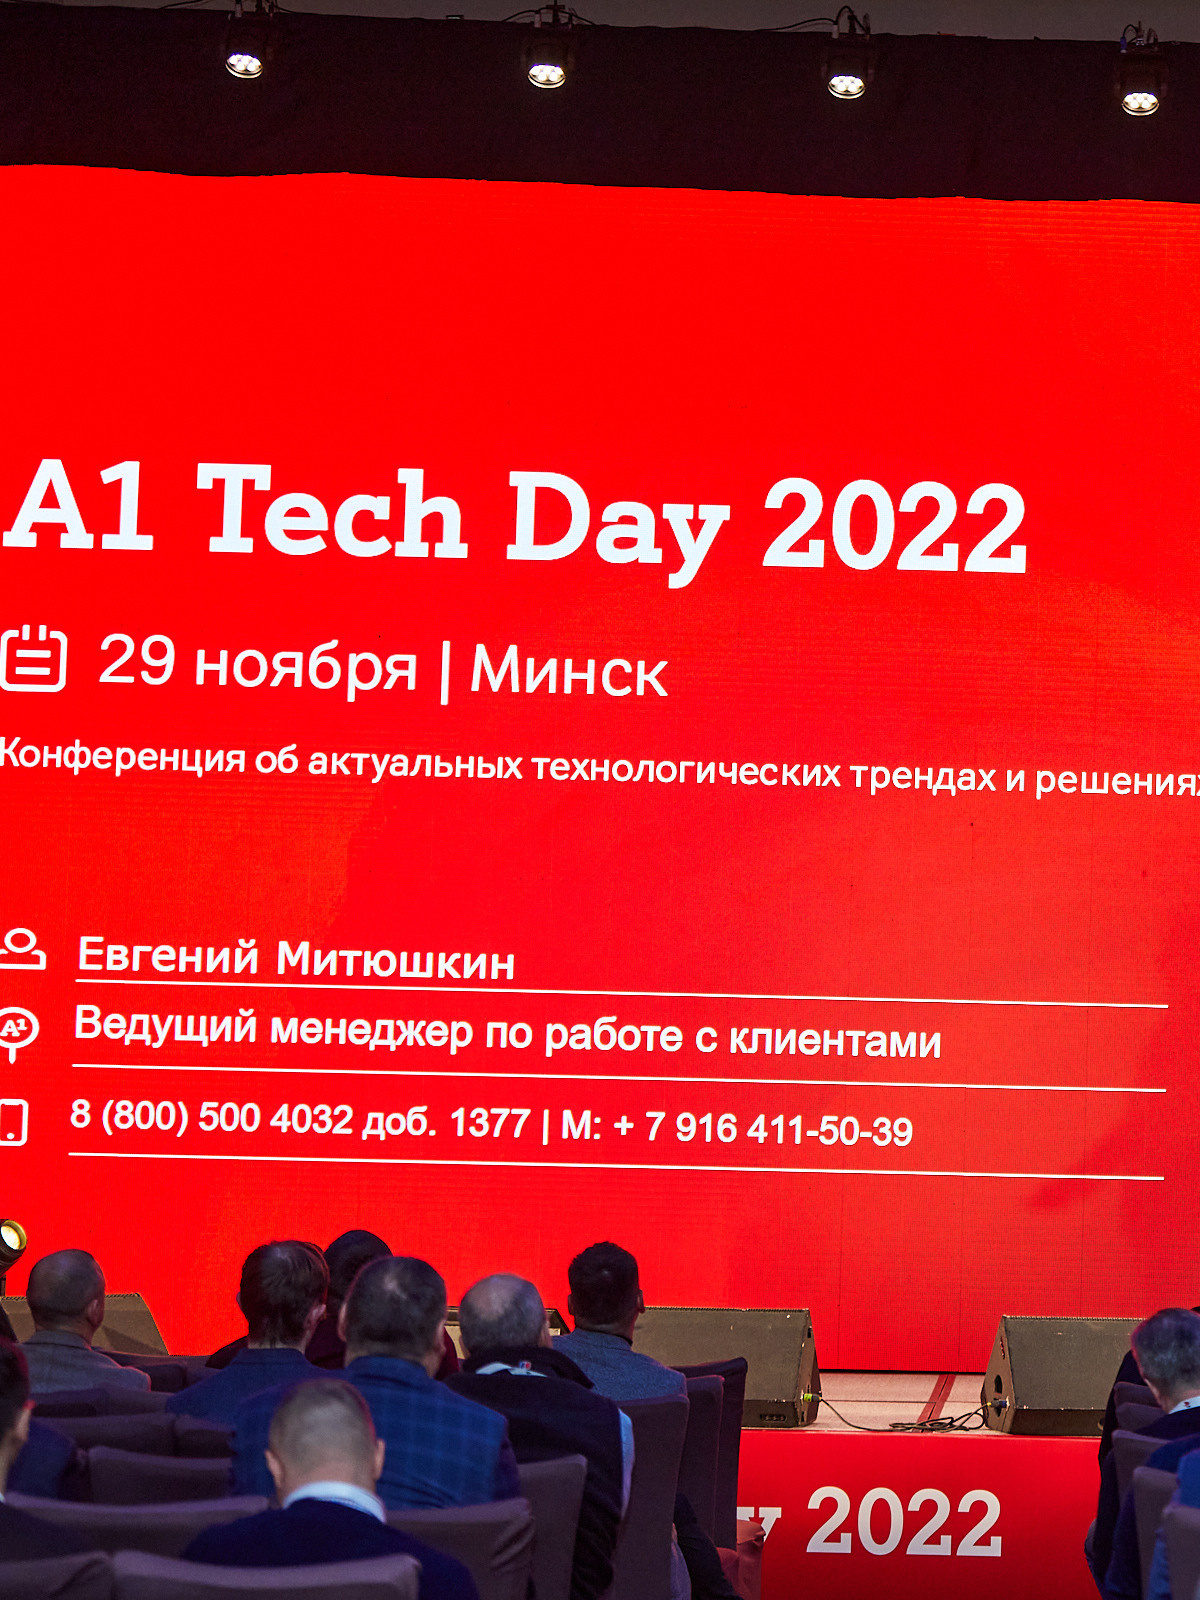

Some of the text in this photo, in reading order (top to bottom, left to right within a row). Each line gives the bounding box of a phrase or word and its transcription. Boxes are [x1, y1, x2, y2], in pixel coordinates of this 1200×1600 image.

[2, 458, 1027, 590] A1 Tech Day 2022
[98, 633, 175, 686] 29
[195, 639, 417, 703] ноября
[470, 643, 669, 697] Минск
[0, 736, 246, 778] Конференция
[255, 743, 299, 774] об
[308, 752, 523, 784] актуальных
[530, 757, 841, 788] технологических
[849, 765, 997, 797] трендах
[1006, 769, 1025, 792] и
[79, 935, 515, 980] Евгений Митюшкин
[75, 1004, 941, 1059] Ведущий менеджер по работе с клиентами
[70, 1098, 91, 1129] 8
[102, 1099, 189, 1138] (800)
[198, 1101, 261, 1133] 500
[269, 1103, 353, 1135] 4032
[361, 1105, 436, 1141] доб.
[451, 1107, 532, 1139] 1377
[645, 1111, 666, 1141] 7
[676, 1112, 737, 1143] 916
[746, 1113, 913, 1147] 411-50-39
[806, 1486, 1002, 1557] 2022
